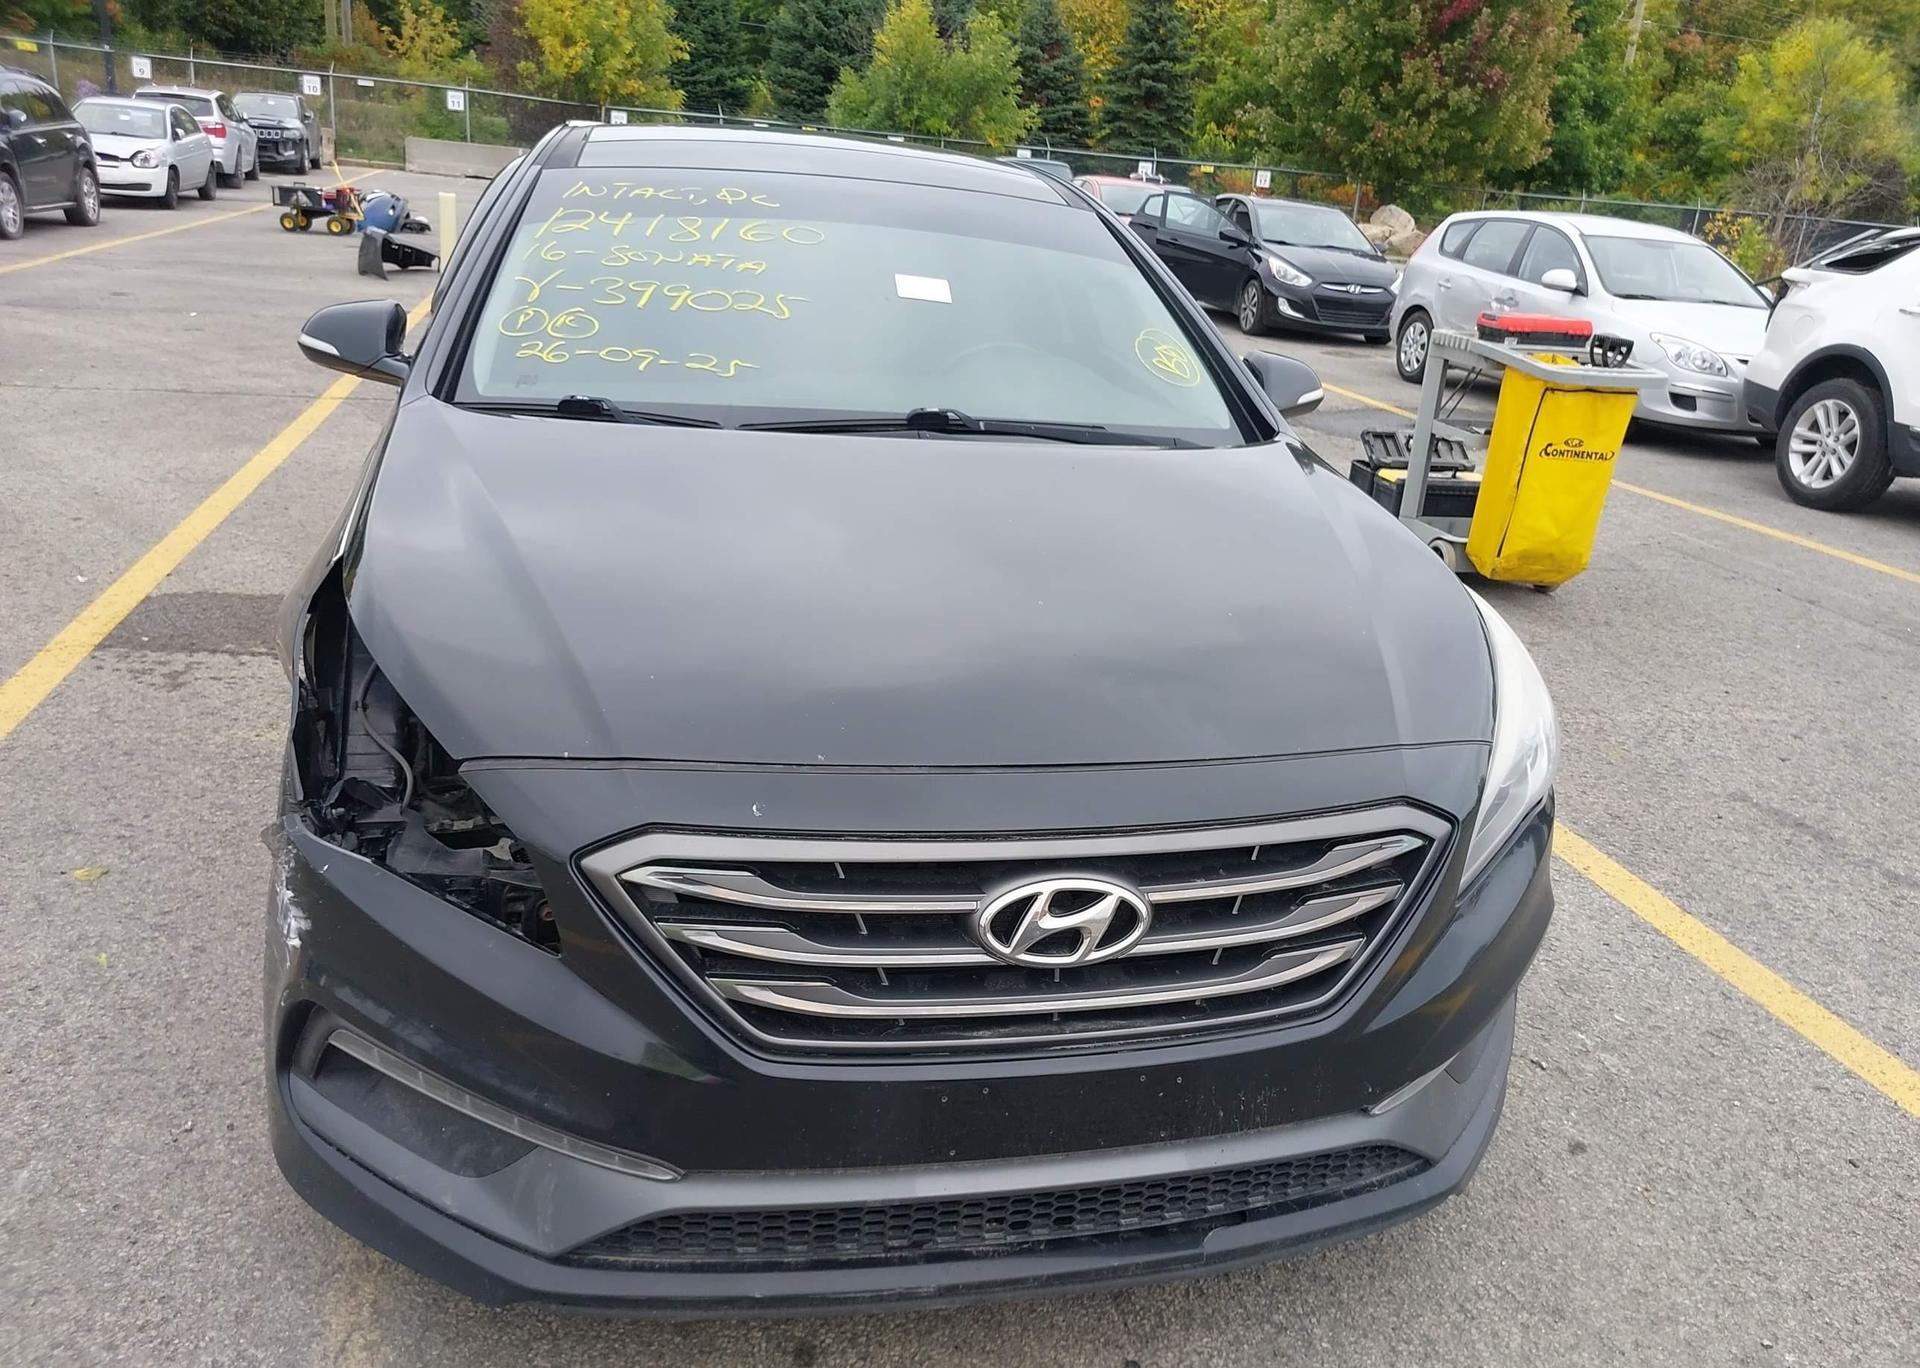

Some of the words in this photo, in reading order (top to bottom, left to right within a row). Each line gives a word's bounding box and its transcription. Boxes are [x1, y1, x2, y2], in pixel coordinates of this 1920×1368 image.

[307, 85, 318, 93] 10
[450, 100, 461, 108] 11
[515, 340, 761, 377] 26-09-25
